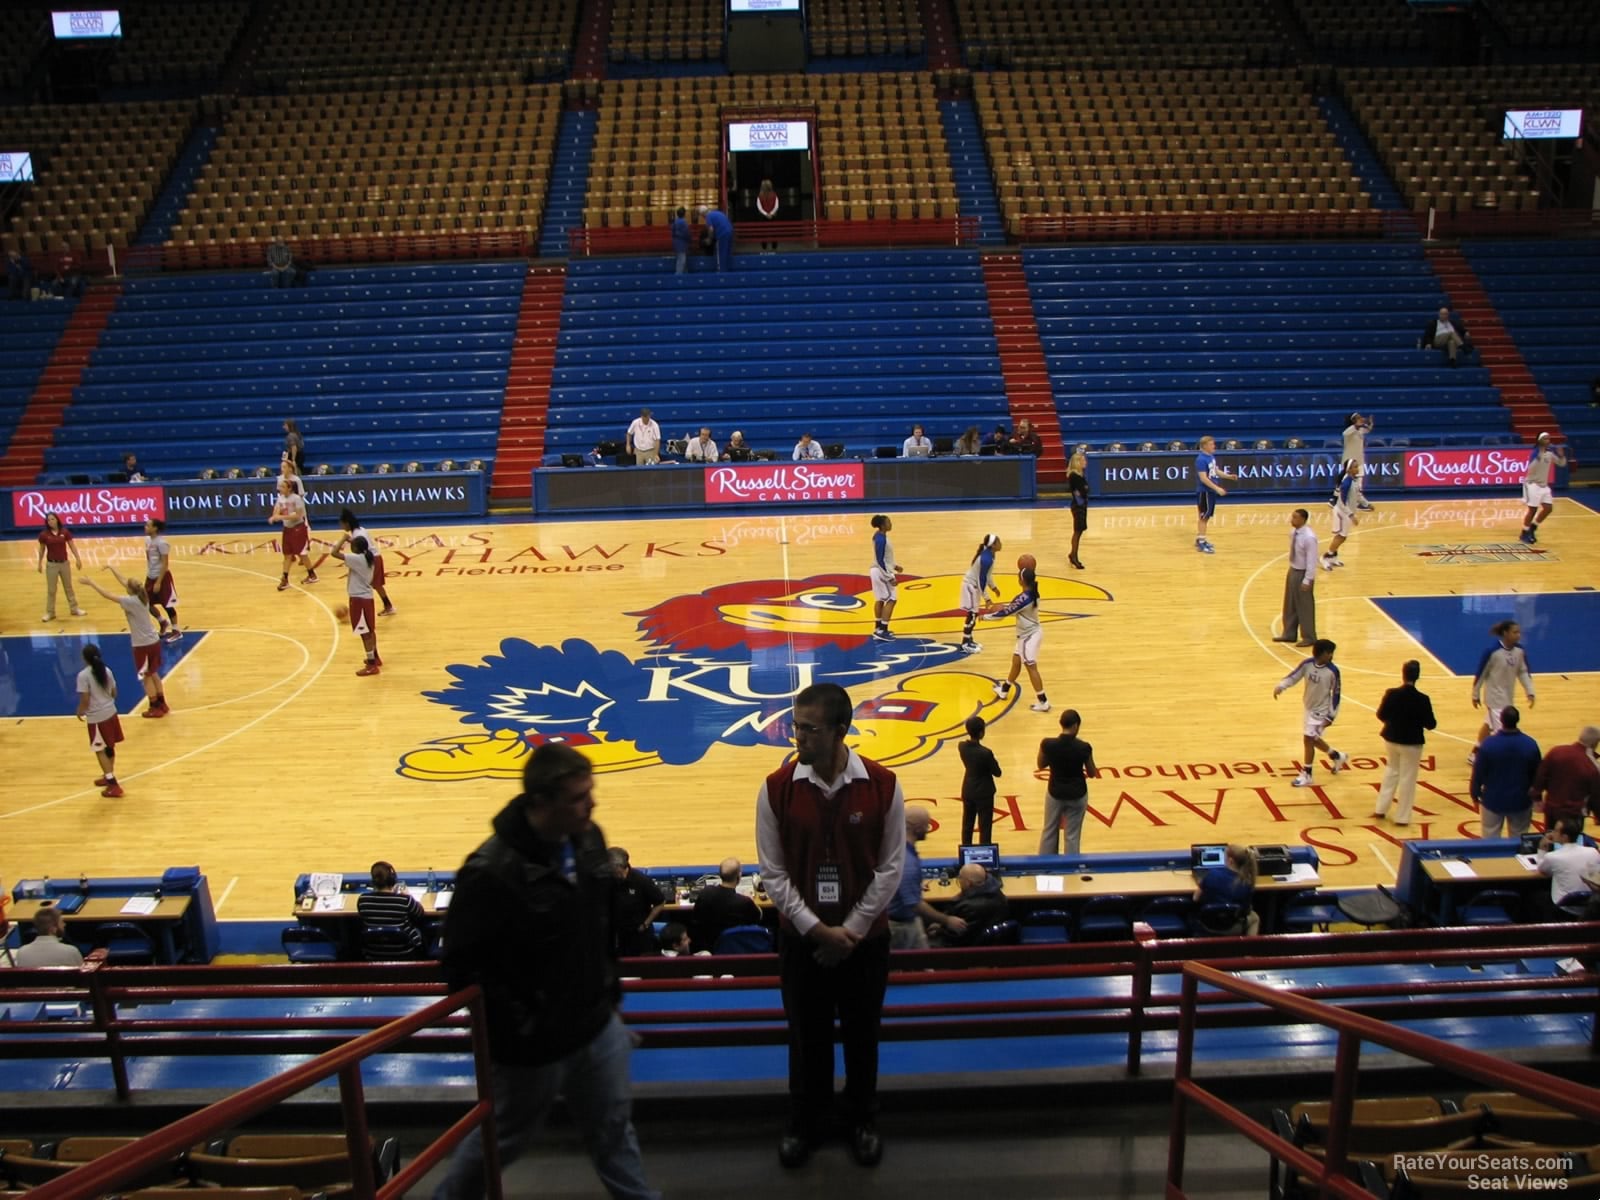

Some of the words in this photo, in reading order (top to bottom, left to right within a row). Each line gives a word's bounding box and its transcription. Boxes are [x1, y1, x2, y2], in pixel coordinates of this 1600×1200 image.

[1523, 119, 1561, 128] KLWN
[750, 131, 788, 140] KLWN
[1105, 466, 1160, 482] HOME
[1166, 465, 1190, 480] OF
[1238, 462, 1303, 478] KANSAS
[1310, 461, 1400, 480] JAYWKS
[1409, 451, 1485, 481] Russell
[1485, 451, 1529, 475] Stov
[710, 467, 791, 497] Russell
[791, 465, 856, 492] Stover
[1454, 476, 1525, 486] CANDIE
[20, 491, 96, 519] Russell
[96, 489, 158, 514] Stover
[169, 495, 222, 510] HOME
[229, 493, 251, 508] OF
[257, 491, 283, 507] TH
[371, 486, 466, 505] JAYHAWKS
[758, 490, 848, 501] CANDIES
[66, 514, 150, 525] CANDIES
[311, 540, 727, 572] JYHAWKS
[436, 563, 625, 578] Fieldhouse
[637, 661, 822, 706] KU
[1033, 760, 1306, 782] Fieldhoue
